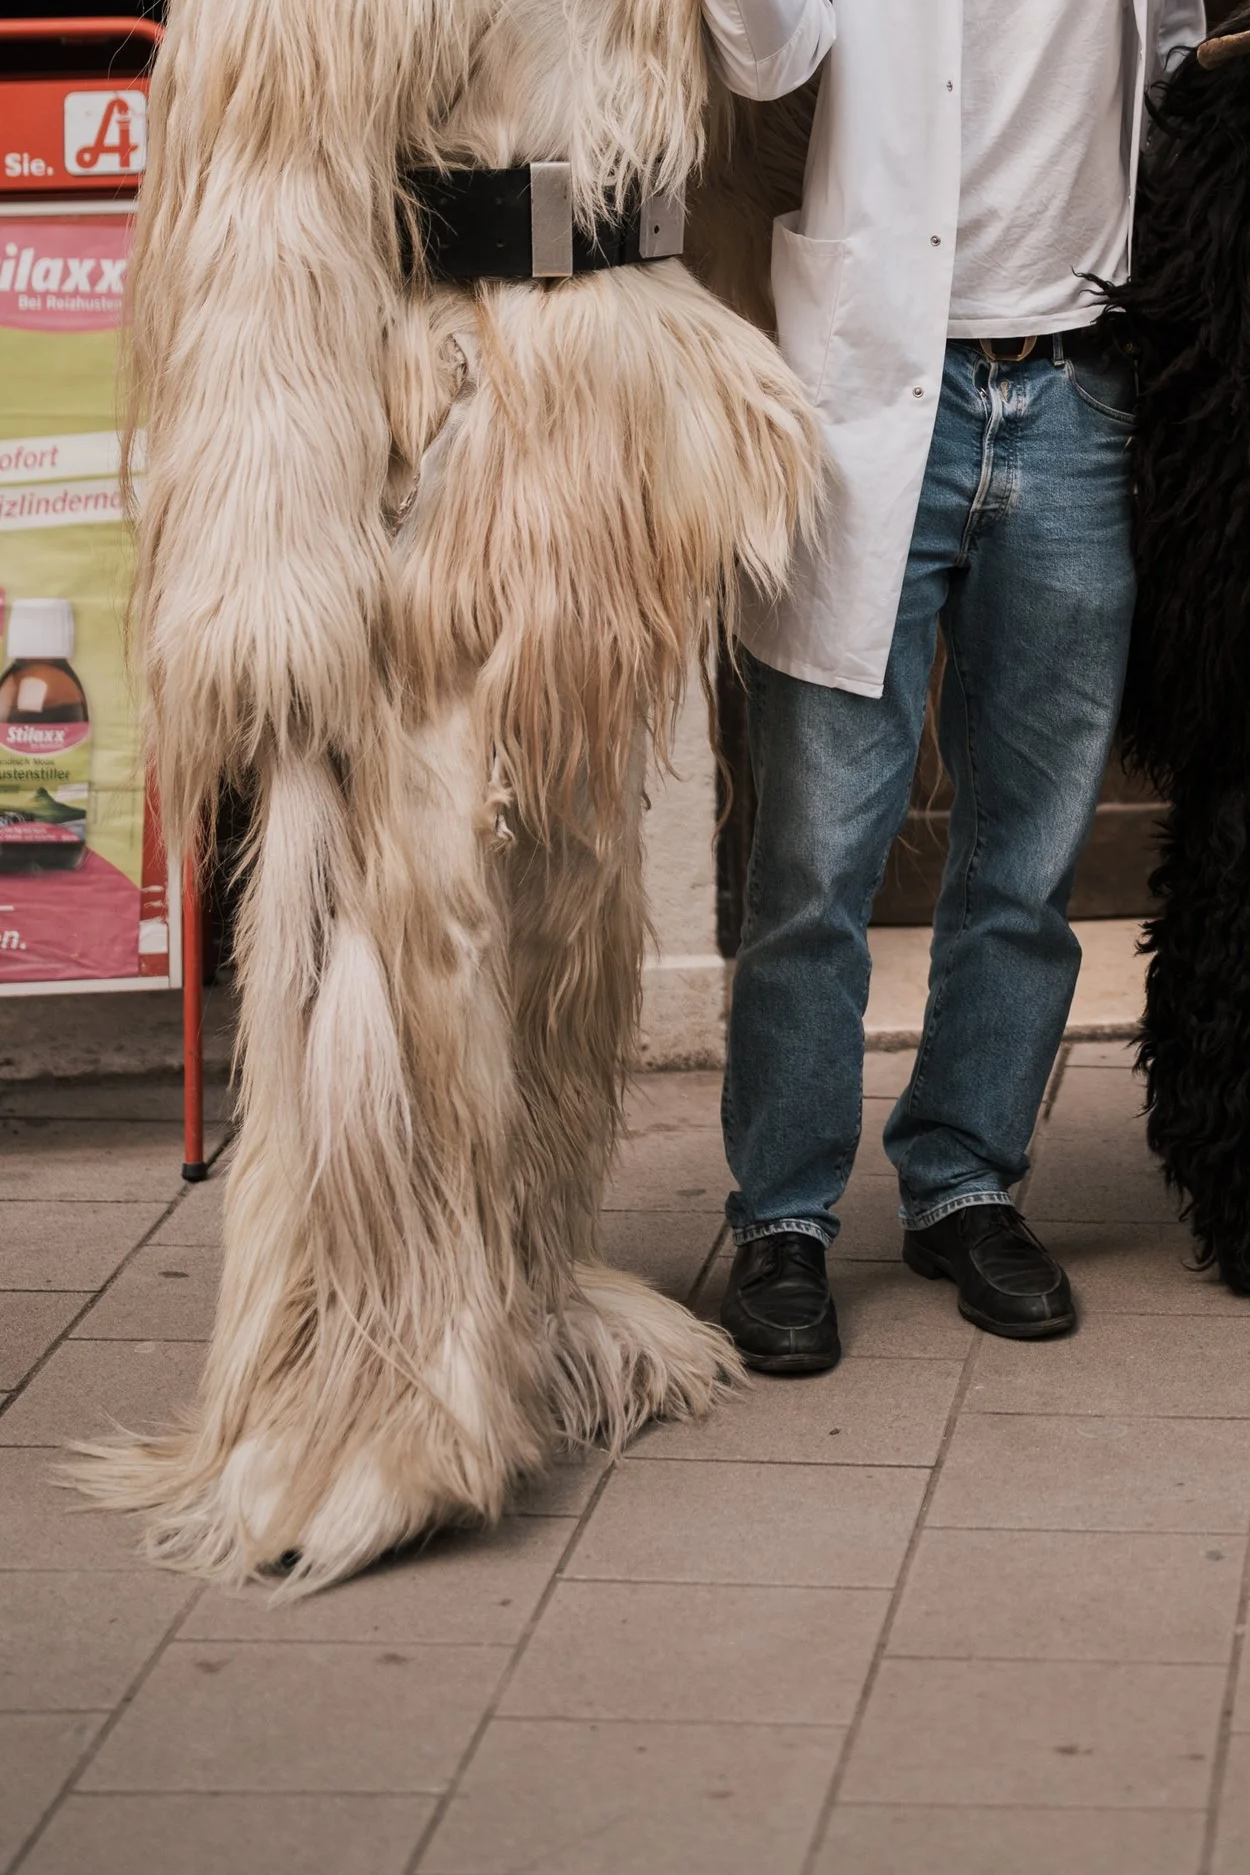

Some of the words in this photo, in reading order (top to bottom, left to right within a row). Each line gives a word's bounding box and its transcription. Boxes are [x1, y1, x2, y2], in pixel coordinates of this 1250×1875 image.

[4, 152, 54, 177] Sie.
[18, 294, 42, 311] Bei
[6, 725, 65, 744] Stilaxx
